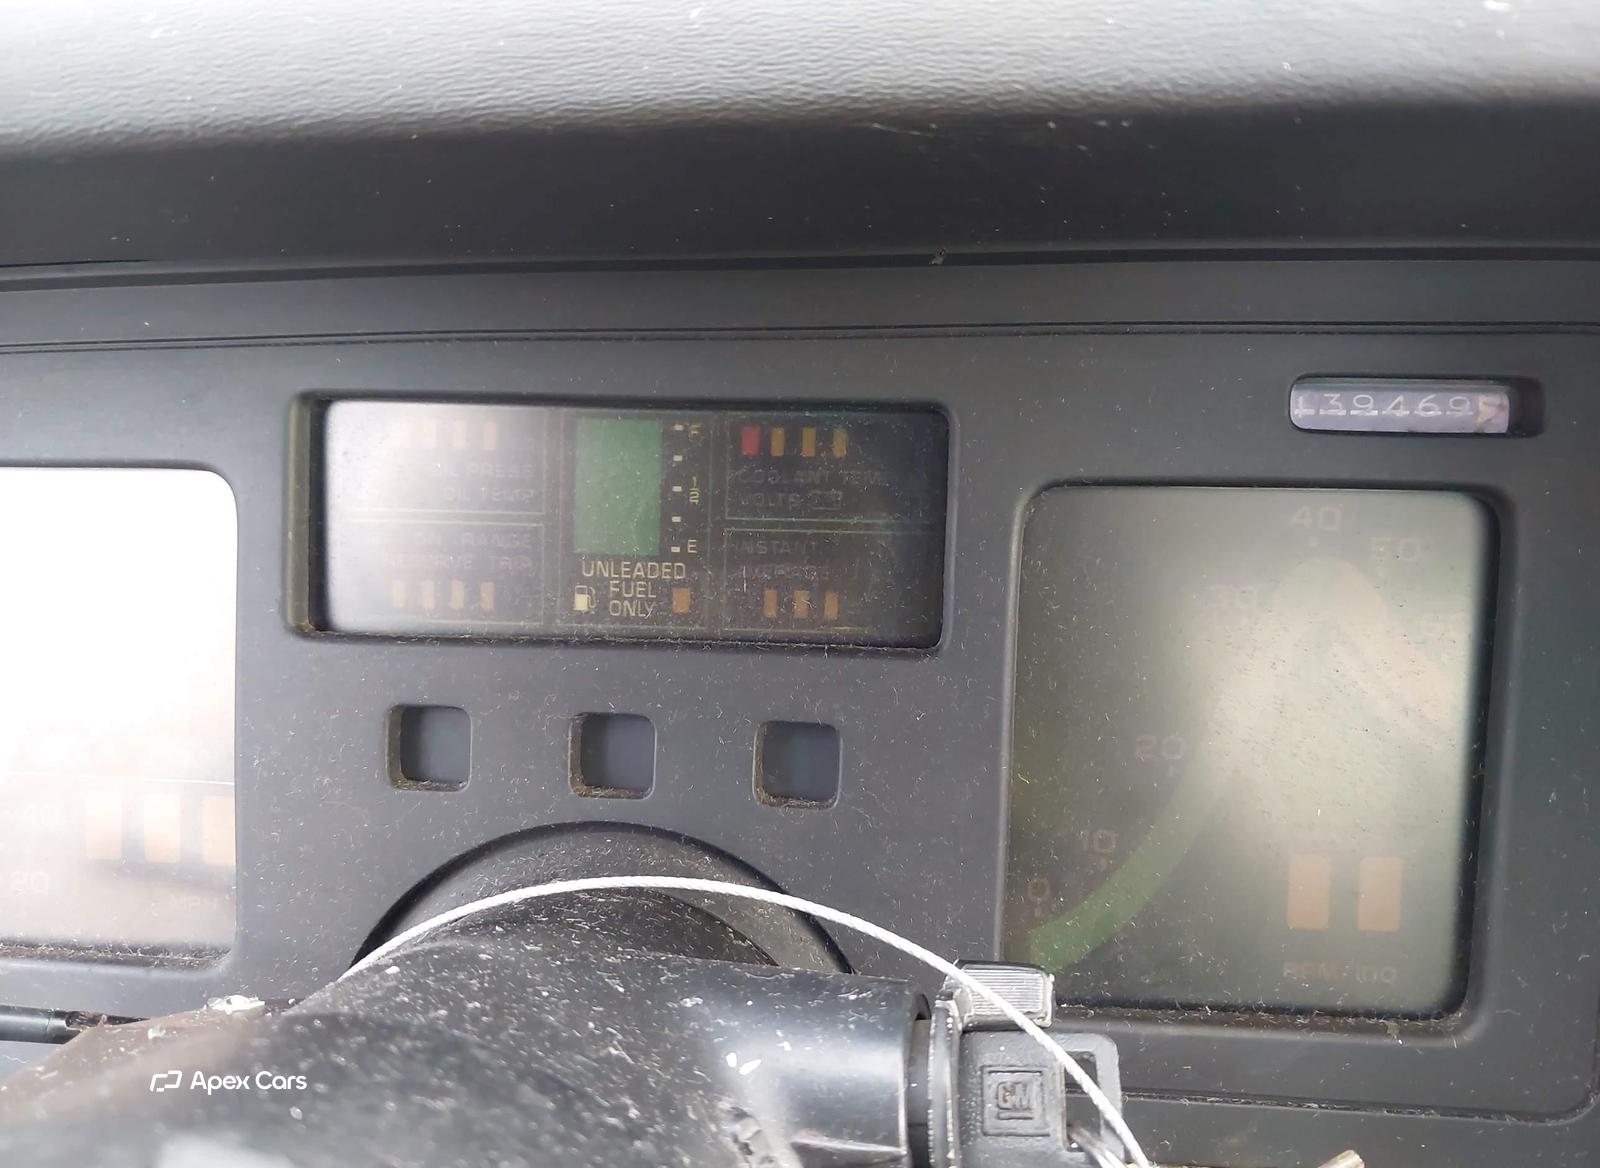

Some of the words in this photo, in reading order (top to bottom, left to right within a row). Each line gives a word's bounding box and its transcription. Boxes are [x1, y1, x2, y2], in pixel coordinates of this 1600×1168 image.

[737, 468, 830, 485] COOLANT
[739, 492, 800, 508] VOLTS
[1290, 504, 1342, 531] 40
[686, 538, 699, 554] E
[735, 540, 818, 555] INSTANT
[1370, 537, 1421, 562] 50
[581, 560, 686, 579] UNLEADED
[608, 580, 657, 598] FUEL
[608, 599, 656, 618] ONLY
[1134, 734, 1187, 761] 20
[18, 804, 60, 827] 40
[1083, 829, 1117, 854] 10
[9, 869, 51, 896] 20
[1026, 878, 1052, 904] 0
[997, 1080, 1034, 1110] GM
